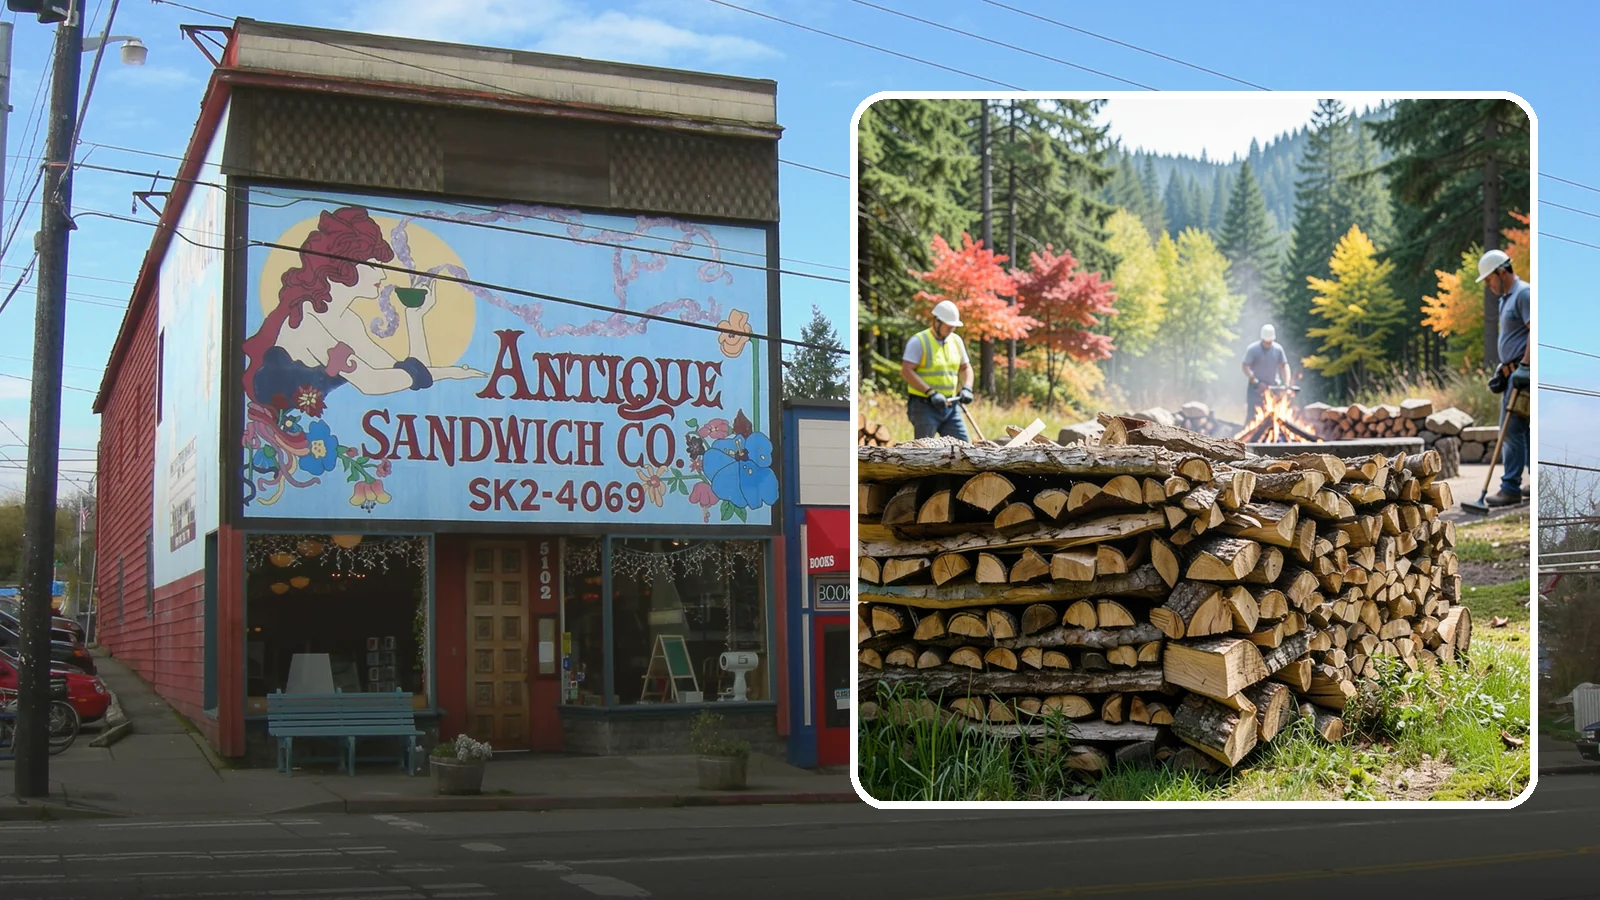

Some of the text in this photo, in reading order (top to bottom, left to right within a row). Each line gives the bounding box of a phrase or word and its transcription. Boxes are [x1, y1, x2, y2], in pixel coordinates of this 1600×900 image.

[475, 329, 724, 420] ANTIQUE
[361, 408, 685, 468] SANDWICH CO.
[468, 477, 645, 513] SK2-4069
[540, 541, 551, 600] 5102
[809, 555, 835, 569] BOOKS
